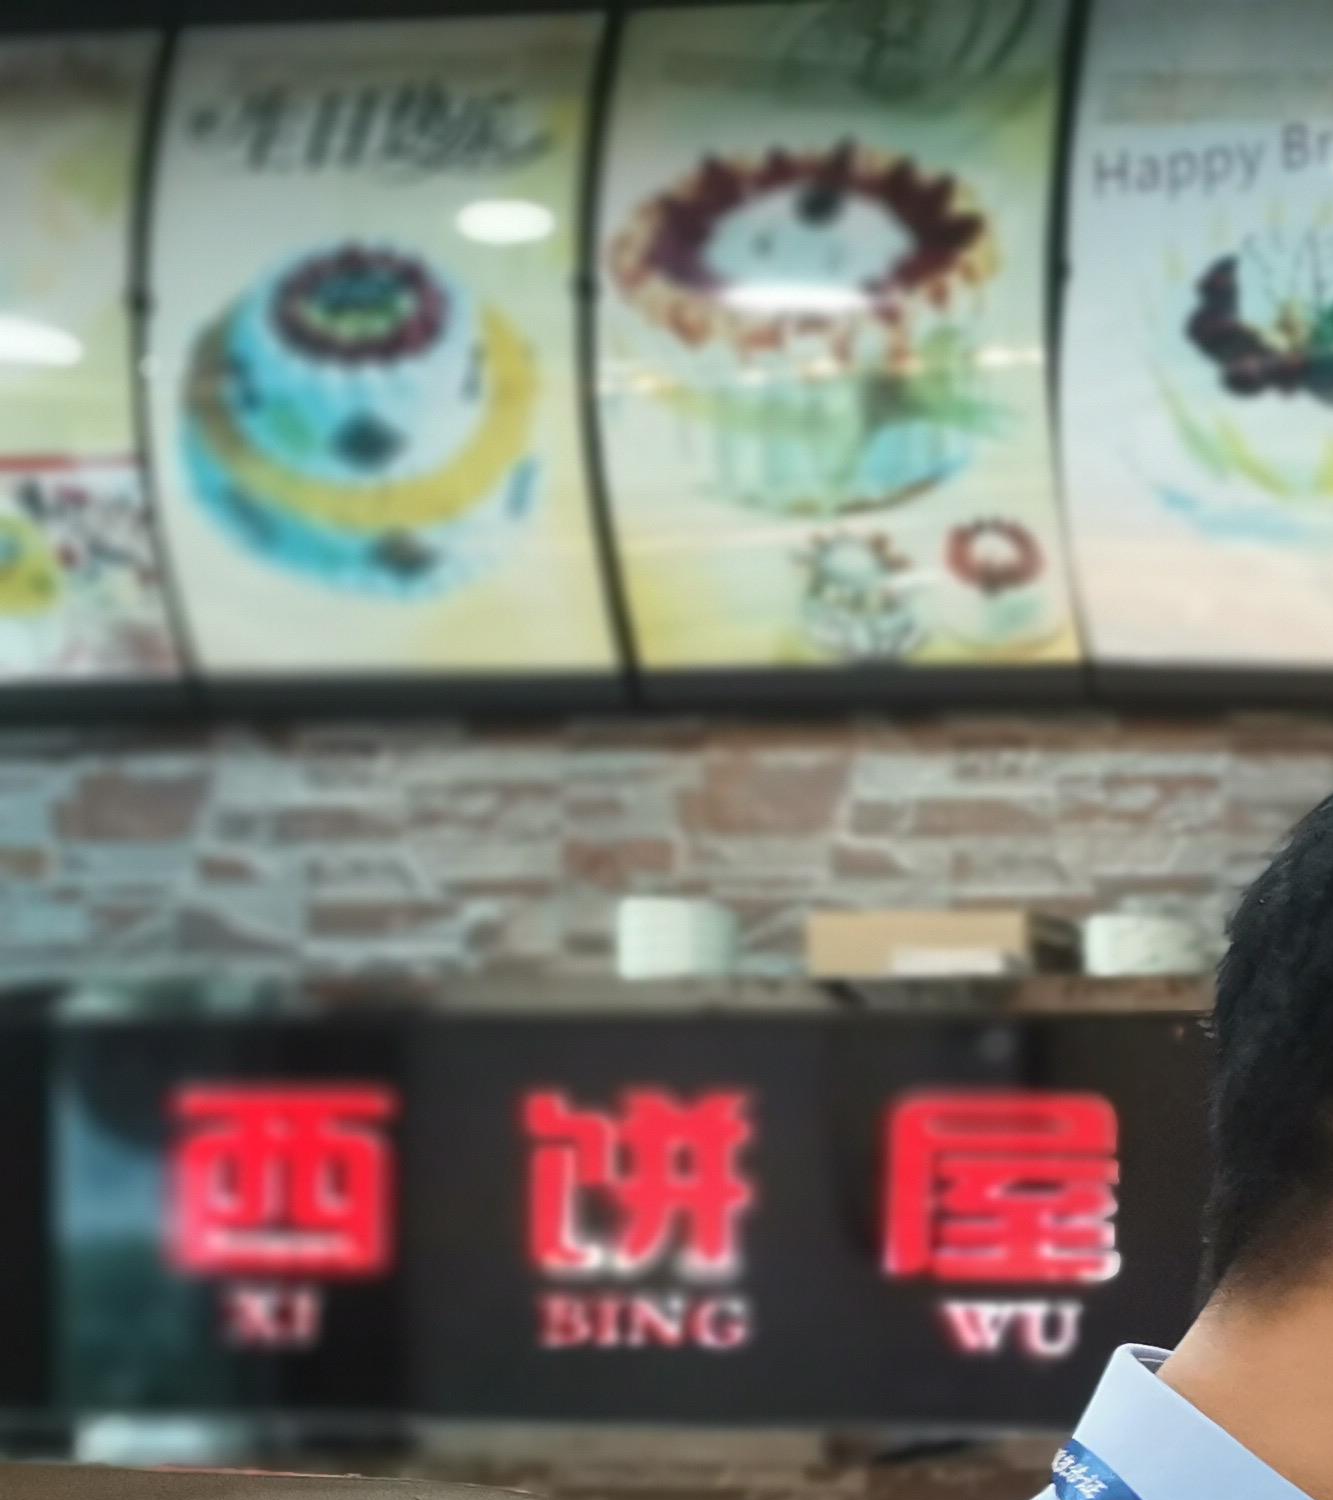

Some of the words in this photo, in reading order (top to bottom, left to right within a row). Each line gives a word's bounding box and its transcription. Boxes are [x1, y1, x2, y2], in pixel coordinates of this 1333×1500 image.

[1092, 138, 1268, 204] Happy
[168, 1082, 1122, 1283] 西饼屋
[220, 1287, 320, 1346] XI
[540, 1294, 749, 1350] BING
[943, 1300, 1083, 1356] WU
